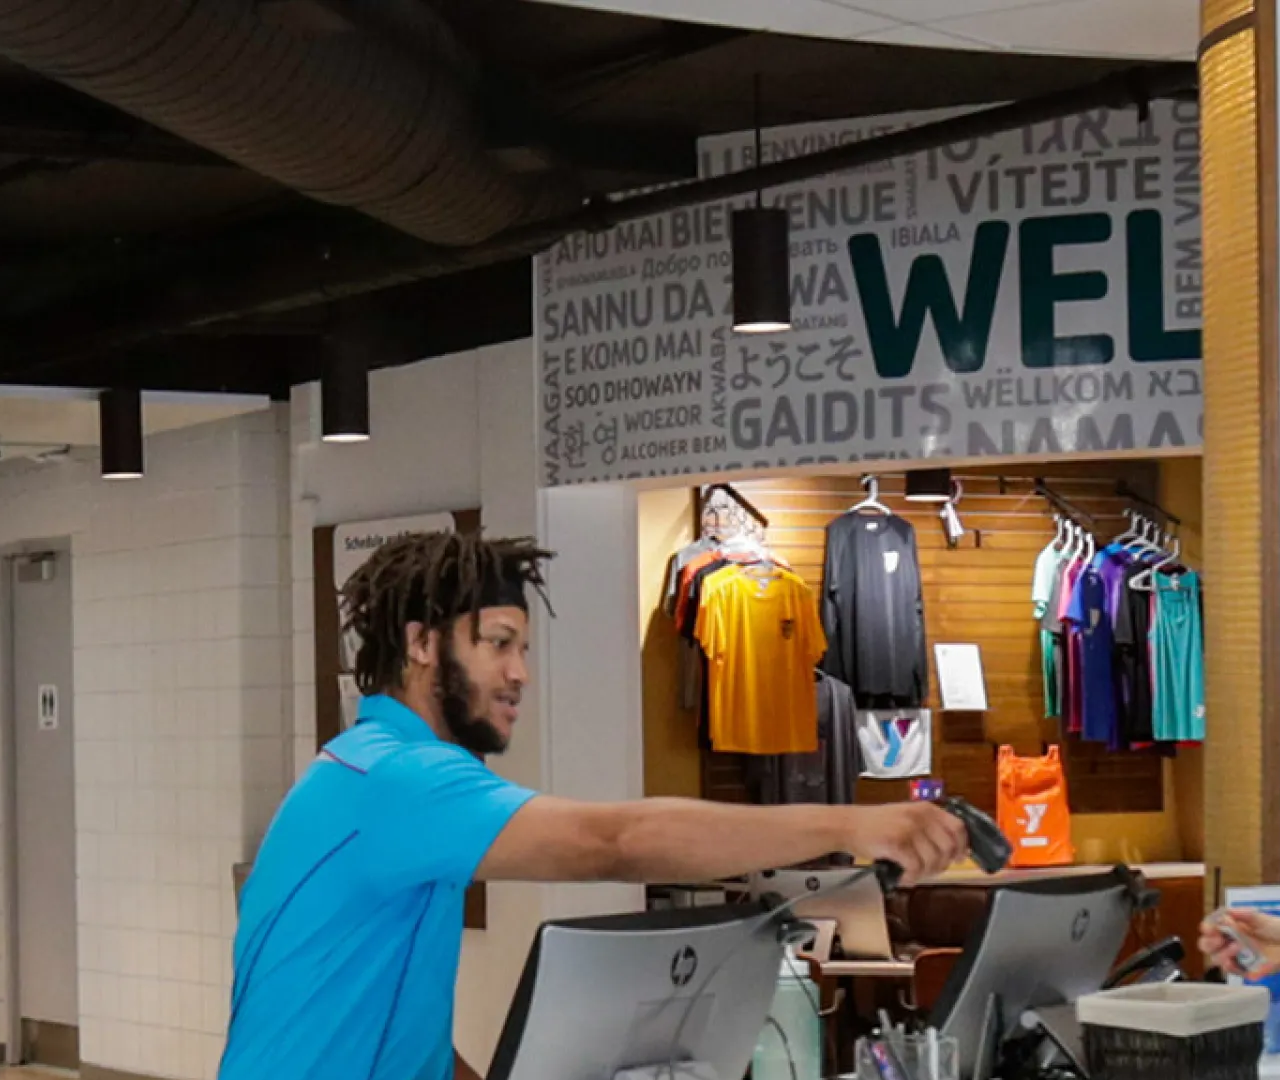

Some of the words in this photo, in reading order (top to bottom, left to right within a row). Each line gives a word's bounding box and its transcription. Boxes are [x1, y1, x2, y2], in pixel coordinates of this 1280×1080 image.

[543, 285, 654, 342] SANNU
[663, 279, 714, 322] DA
[564, 347, 576, 376] E
[581, 336, 648, 372] KOMO
[655, 330, 702, 362] MAI
[730, 334, 863, 391] ようこそ
[564, 382, 600, 409] SOO
[604, 371, 703, 403] DHOWAYN
[623, 404, 702, 433] WOEZOR
[730, 382, 952, 451] GAIDITS
